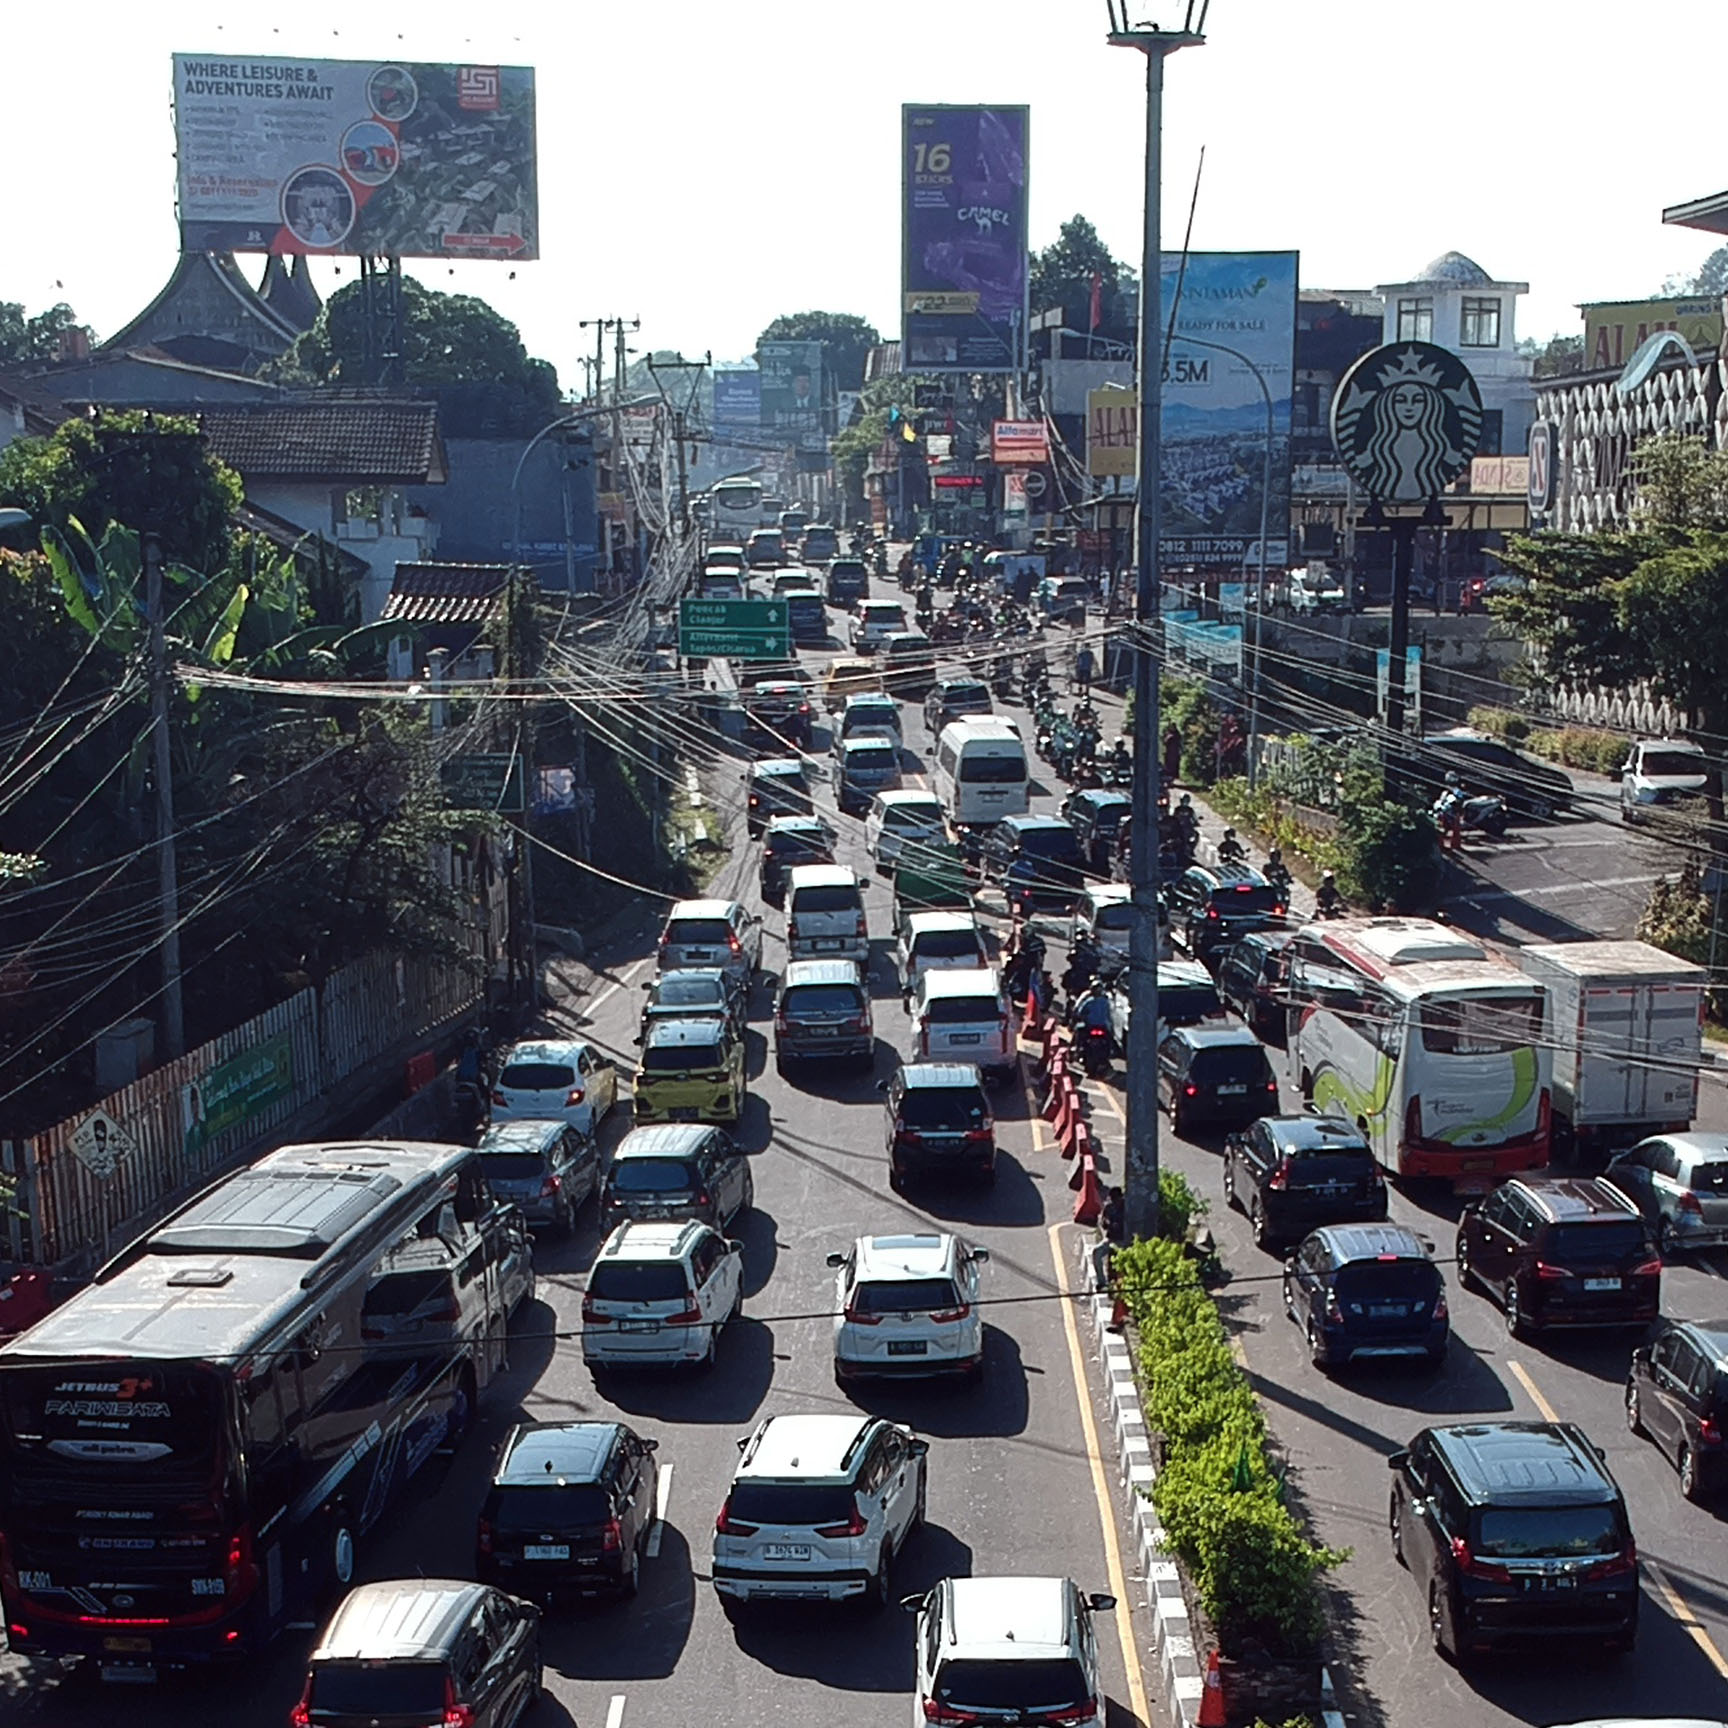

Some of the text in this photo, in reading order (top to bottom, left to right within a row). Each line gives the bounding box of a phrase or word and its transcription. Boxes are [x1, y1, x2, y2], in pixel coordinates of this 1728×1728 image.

[184, 62, 318, 82] WHERE LEISURE &
[185, 80, 335, 101] ADVENTURES AWAIT
[913, 143, 952, 174] 16
[957, 206, 1010, 227] CAMEL
[1090, 406, 1139, 448] ALA
[44, 1400, 172, 1418] PARIWISATA
